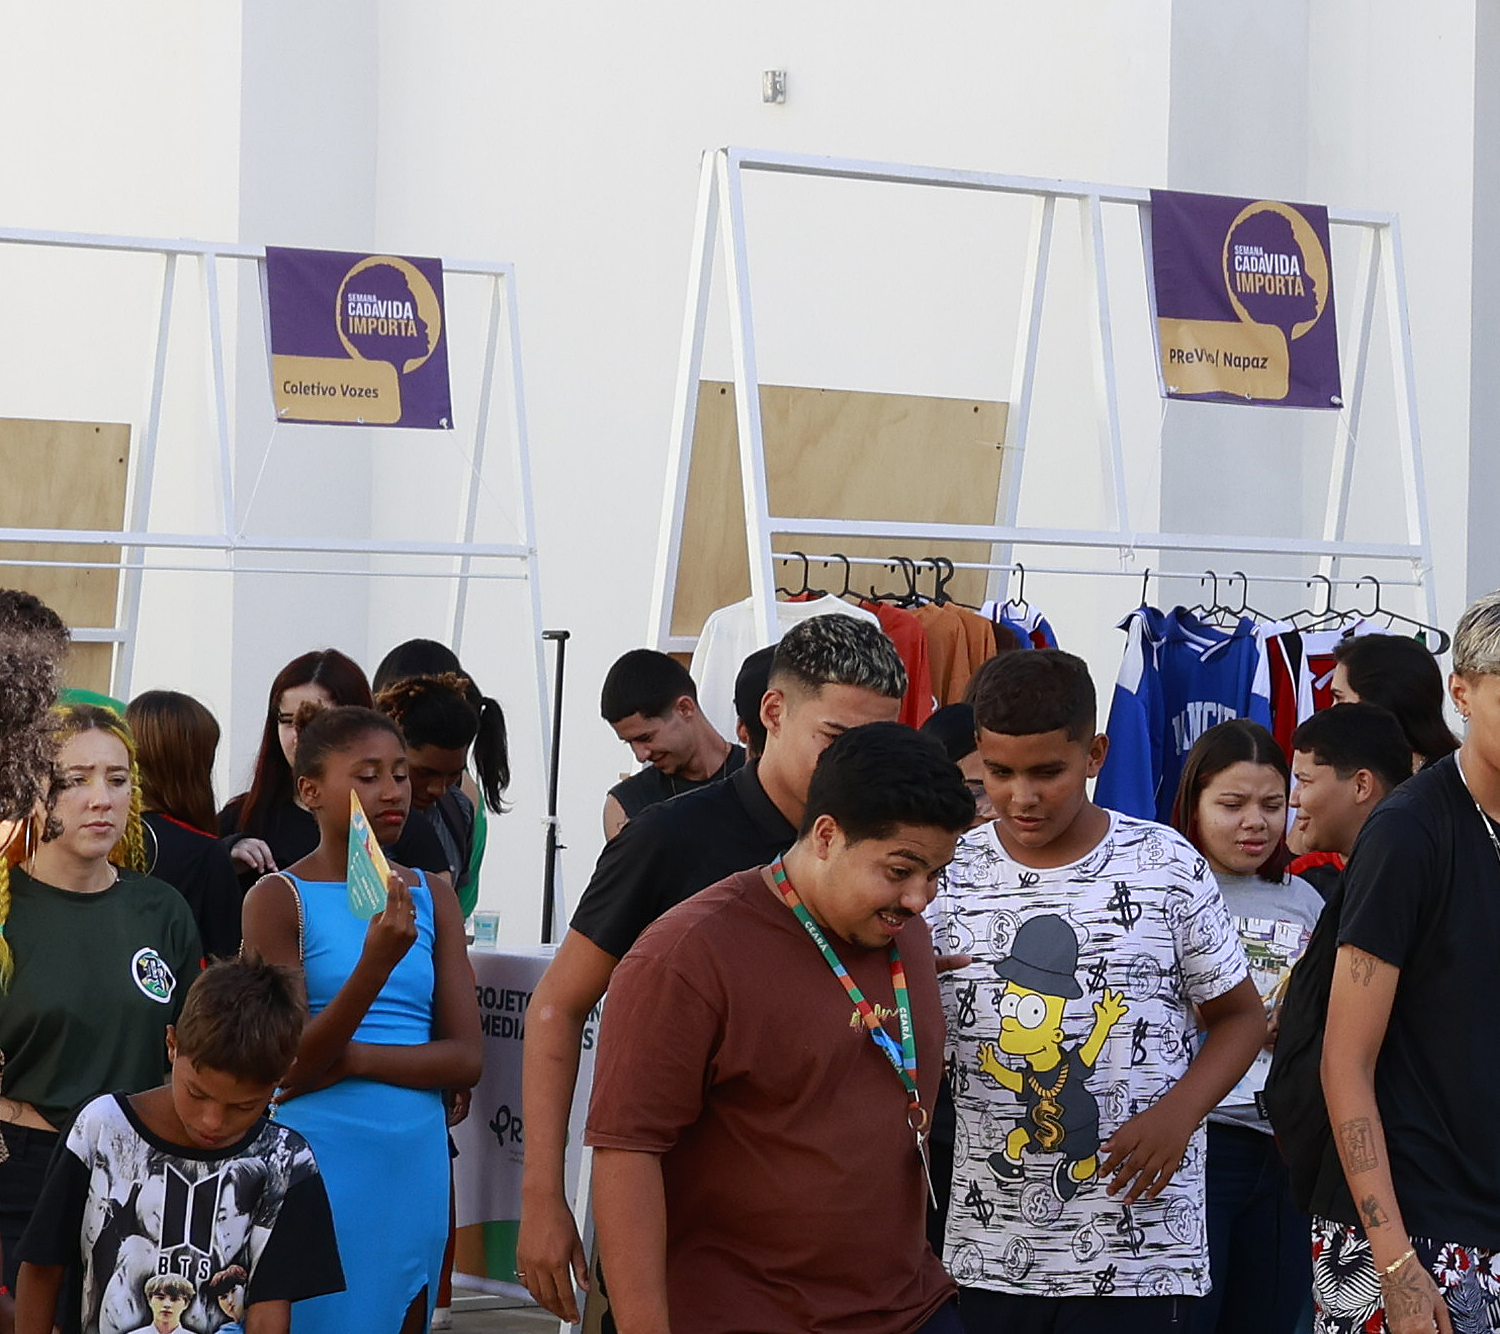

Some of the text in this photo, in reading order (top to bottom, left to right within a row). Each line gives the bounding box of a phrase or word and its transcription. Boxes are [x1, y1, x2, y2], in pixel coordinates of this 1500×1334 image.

[1233, 244, 1264, 256] SEMANA
[1234, 253, 1301, 276] CADA VIDA
[1236, 272, 1305, 297] IMPORTA
[347, 293, 378, 303] SEMANA
[348, 300, 414, 320] CADA VIDA
[349, 316, 418, 338] IMPORTA
[1223, 351, 1269, 372] Napaz
[283, 380, 379, 399] Coletivo Vozes
[804, 920, 828, 952] CEARÁ
[899, 1006, 913, 1041] CEARÁ
[158, 1256, 210, 1280] BTS
